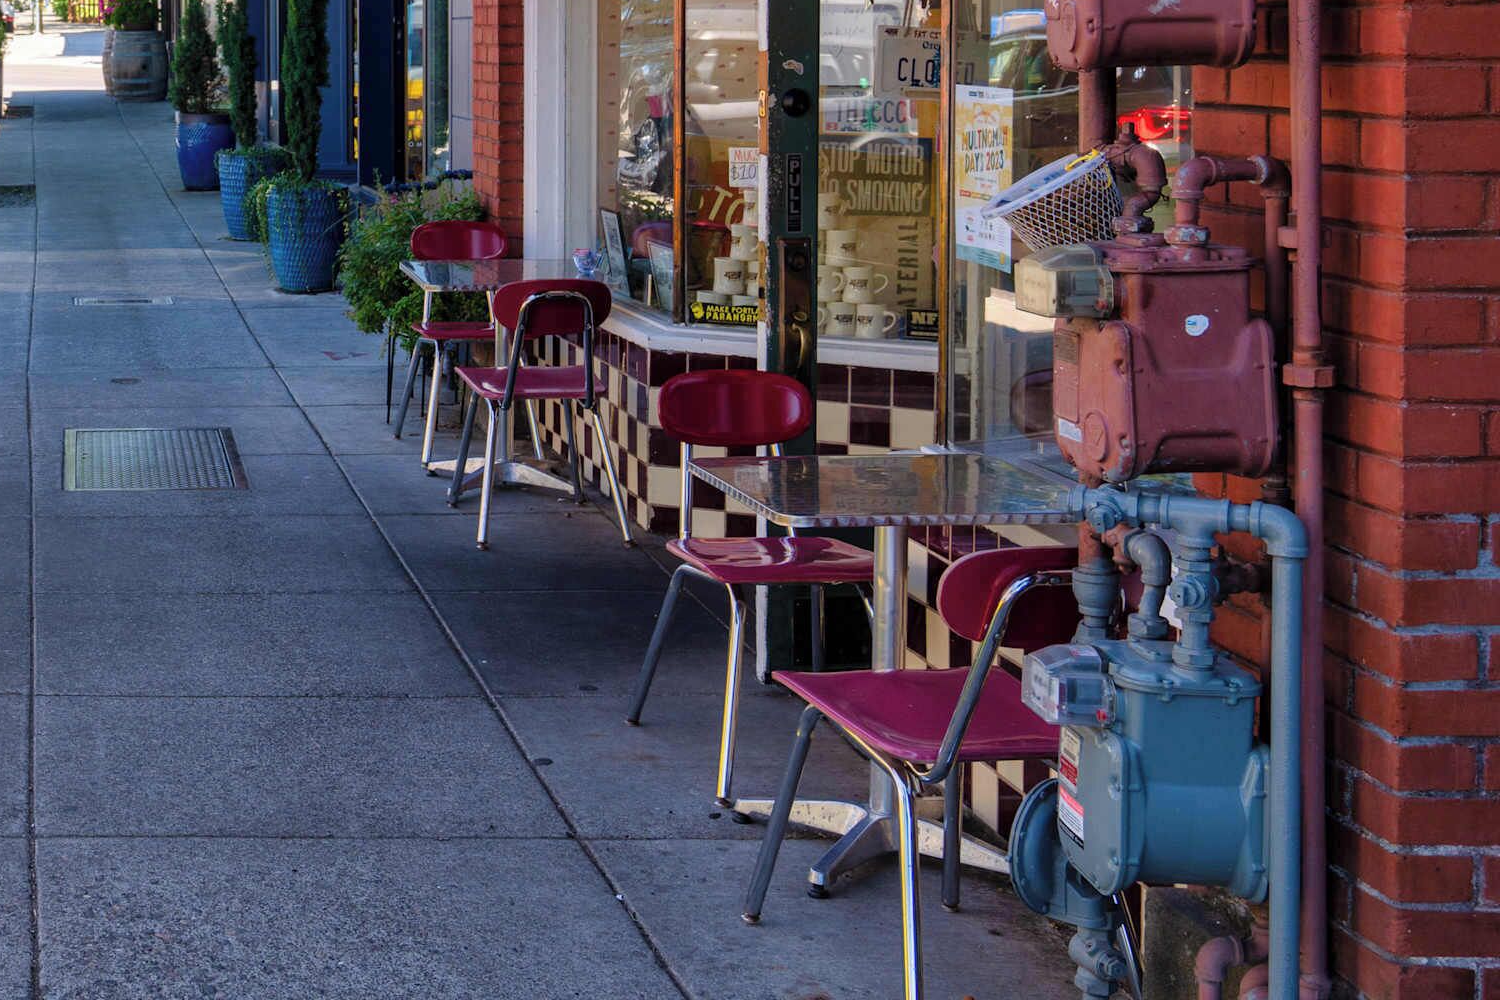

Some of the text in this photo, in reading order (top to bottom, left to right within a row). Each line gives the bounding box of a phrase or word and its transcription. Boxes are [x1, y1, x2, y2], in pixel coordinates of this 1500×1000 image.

[897, 57, 975, 86] CLOD
[961, 125, 1009, 152] MULTNOMAH
[731, 165, 757, 180] $10
[819, 142, 926, 175] STOP MOTOR
[965, 150, 1005, 174] DAYS 2023
[789, 159, 800, 214] PULL
[846, 181, 926, 213] SMOKING
[897, 220, 919, 308] ATERIAL
[706, 304, 758, 316] MAKE PORTLA
[706, 312, 758, 323] PARANORM
